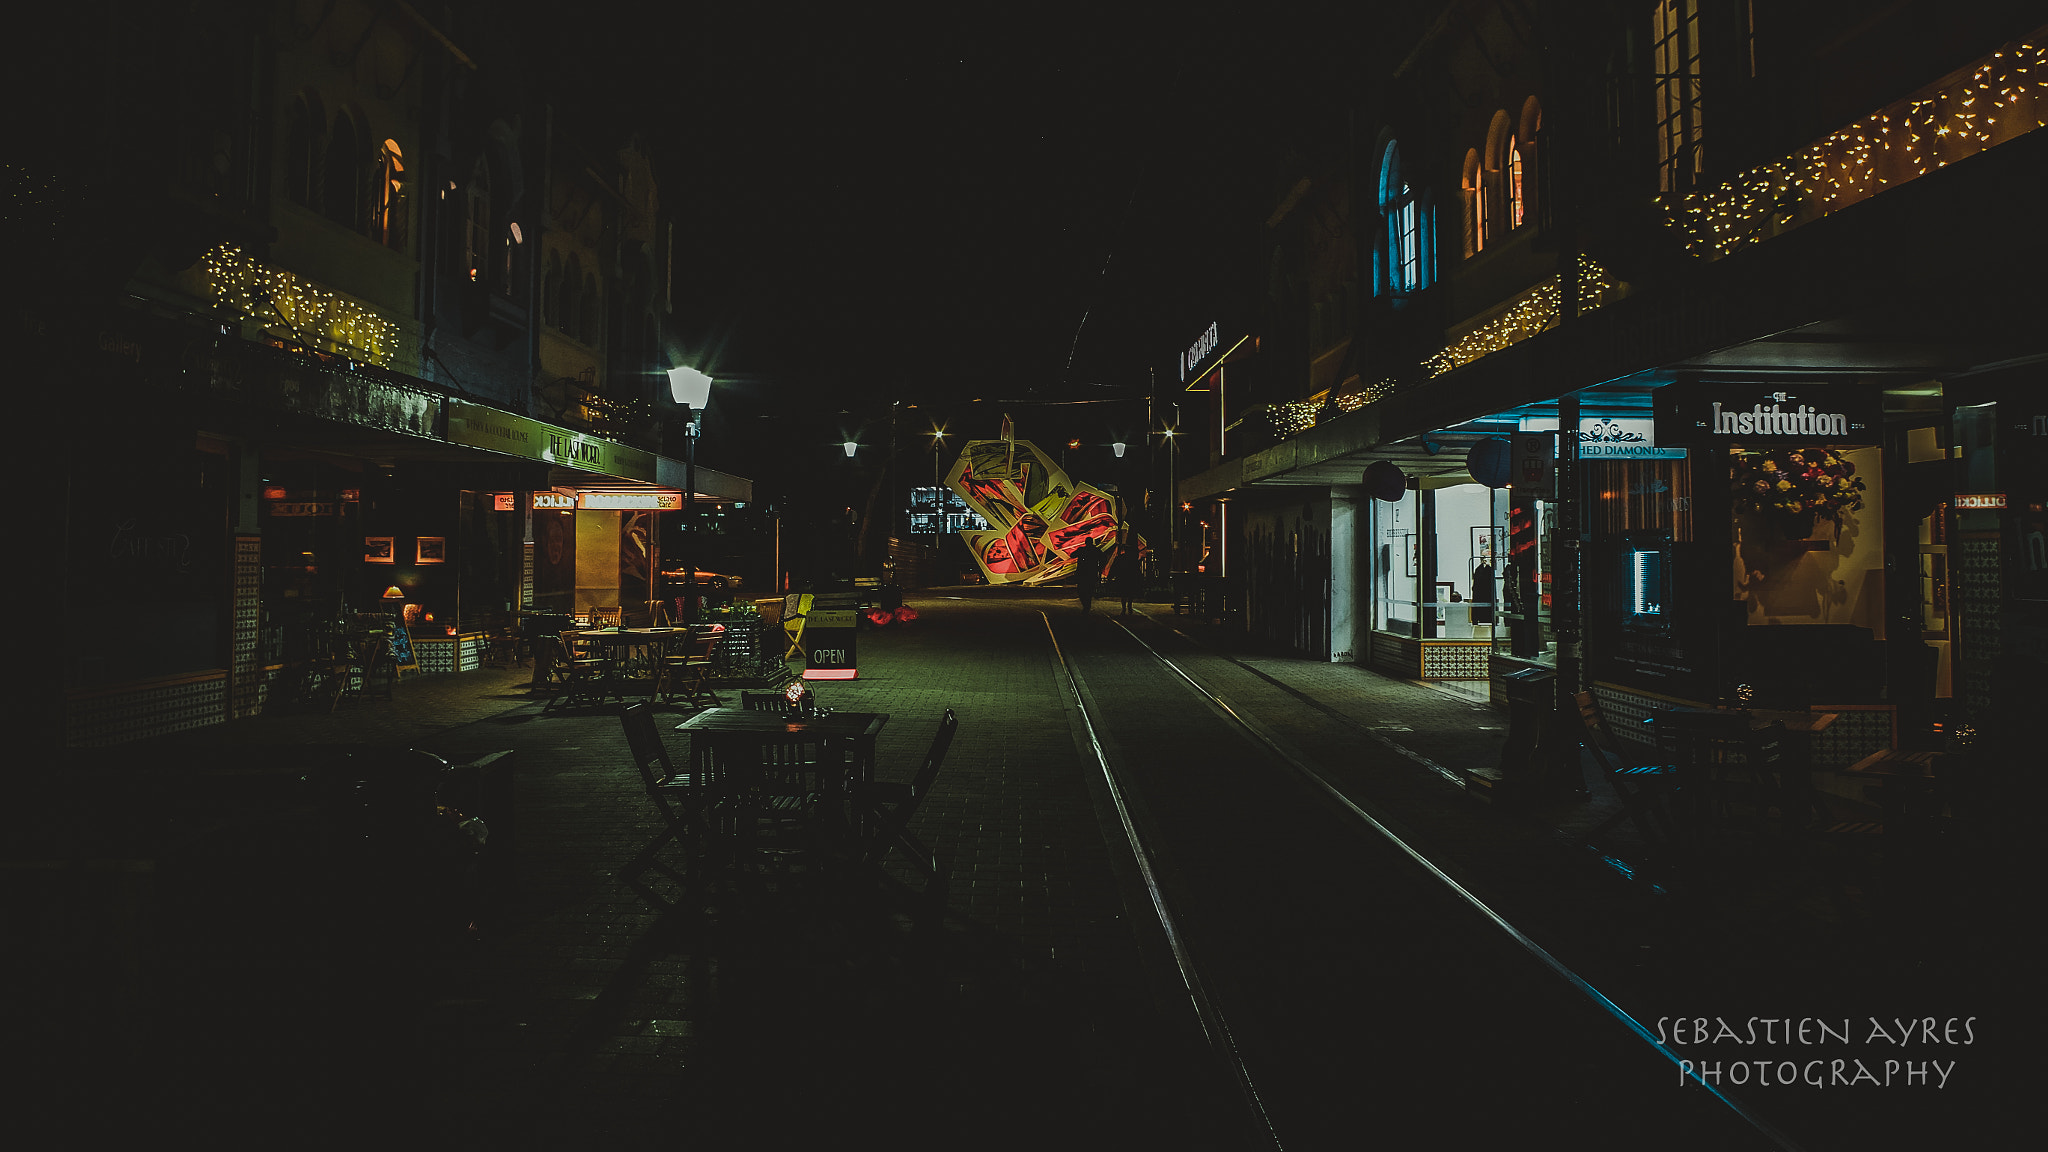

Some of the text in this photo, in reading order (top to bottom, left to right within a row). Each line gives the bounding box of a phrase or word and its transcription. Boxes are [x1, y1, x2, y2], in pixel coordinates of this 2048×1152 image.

[1712, 402, 1848, 436] Institution
[549, 434, 562, 456] THE
[564, 438, 580, 460] LAST
[1605, 446, 1666, 455] DIAMONDS
[814, 649, 846, 664] OPEN
